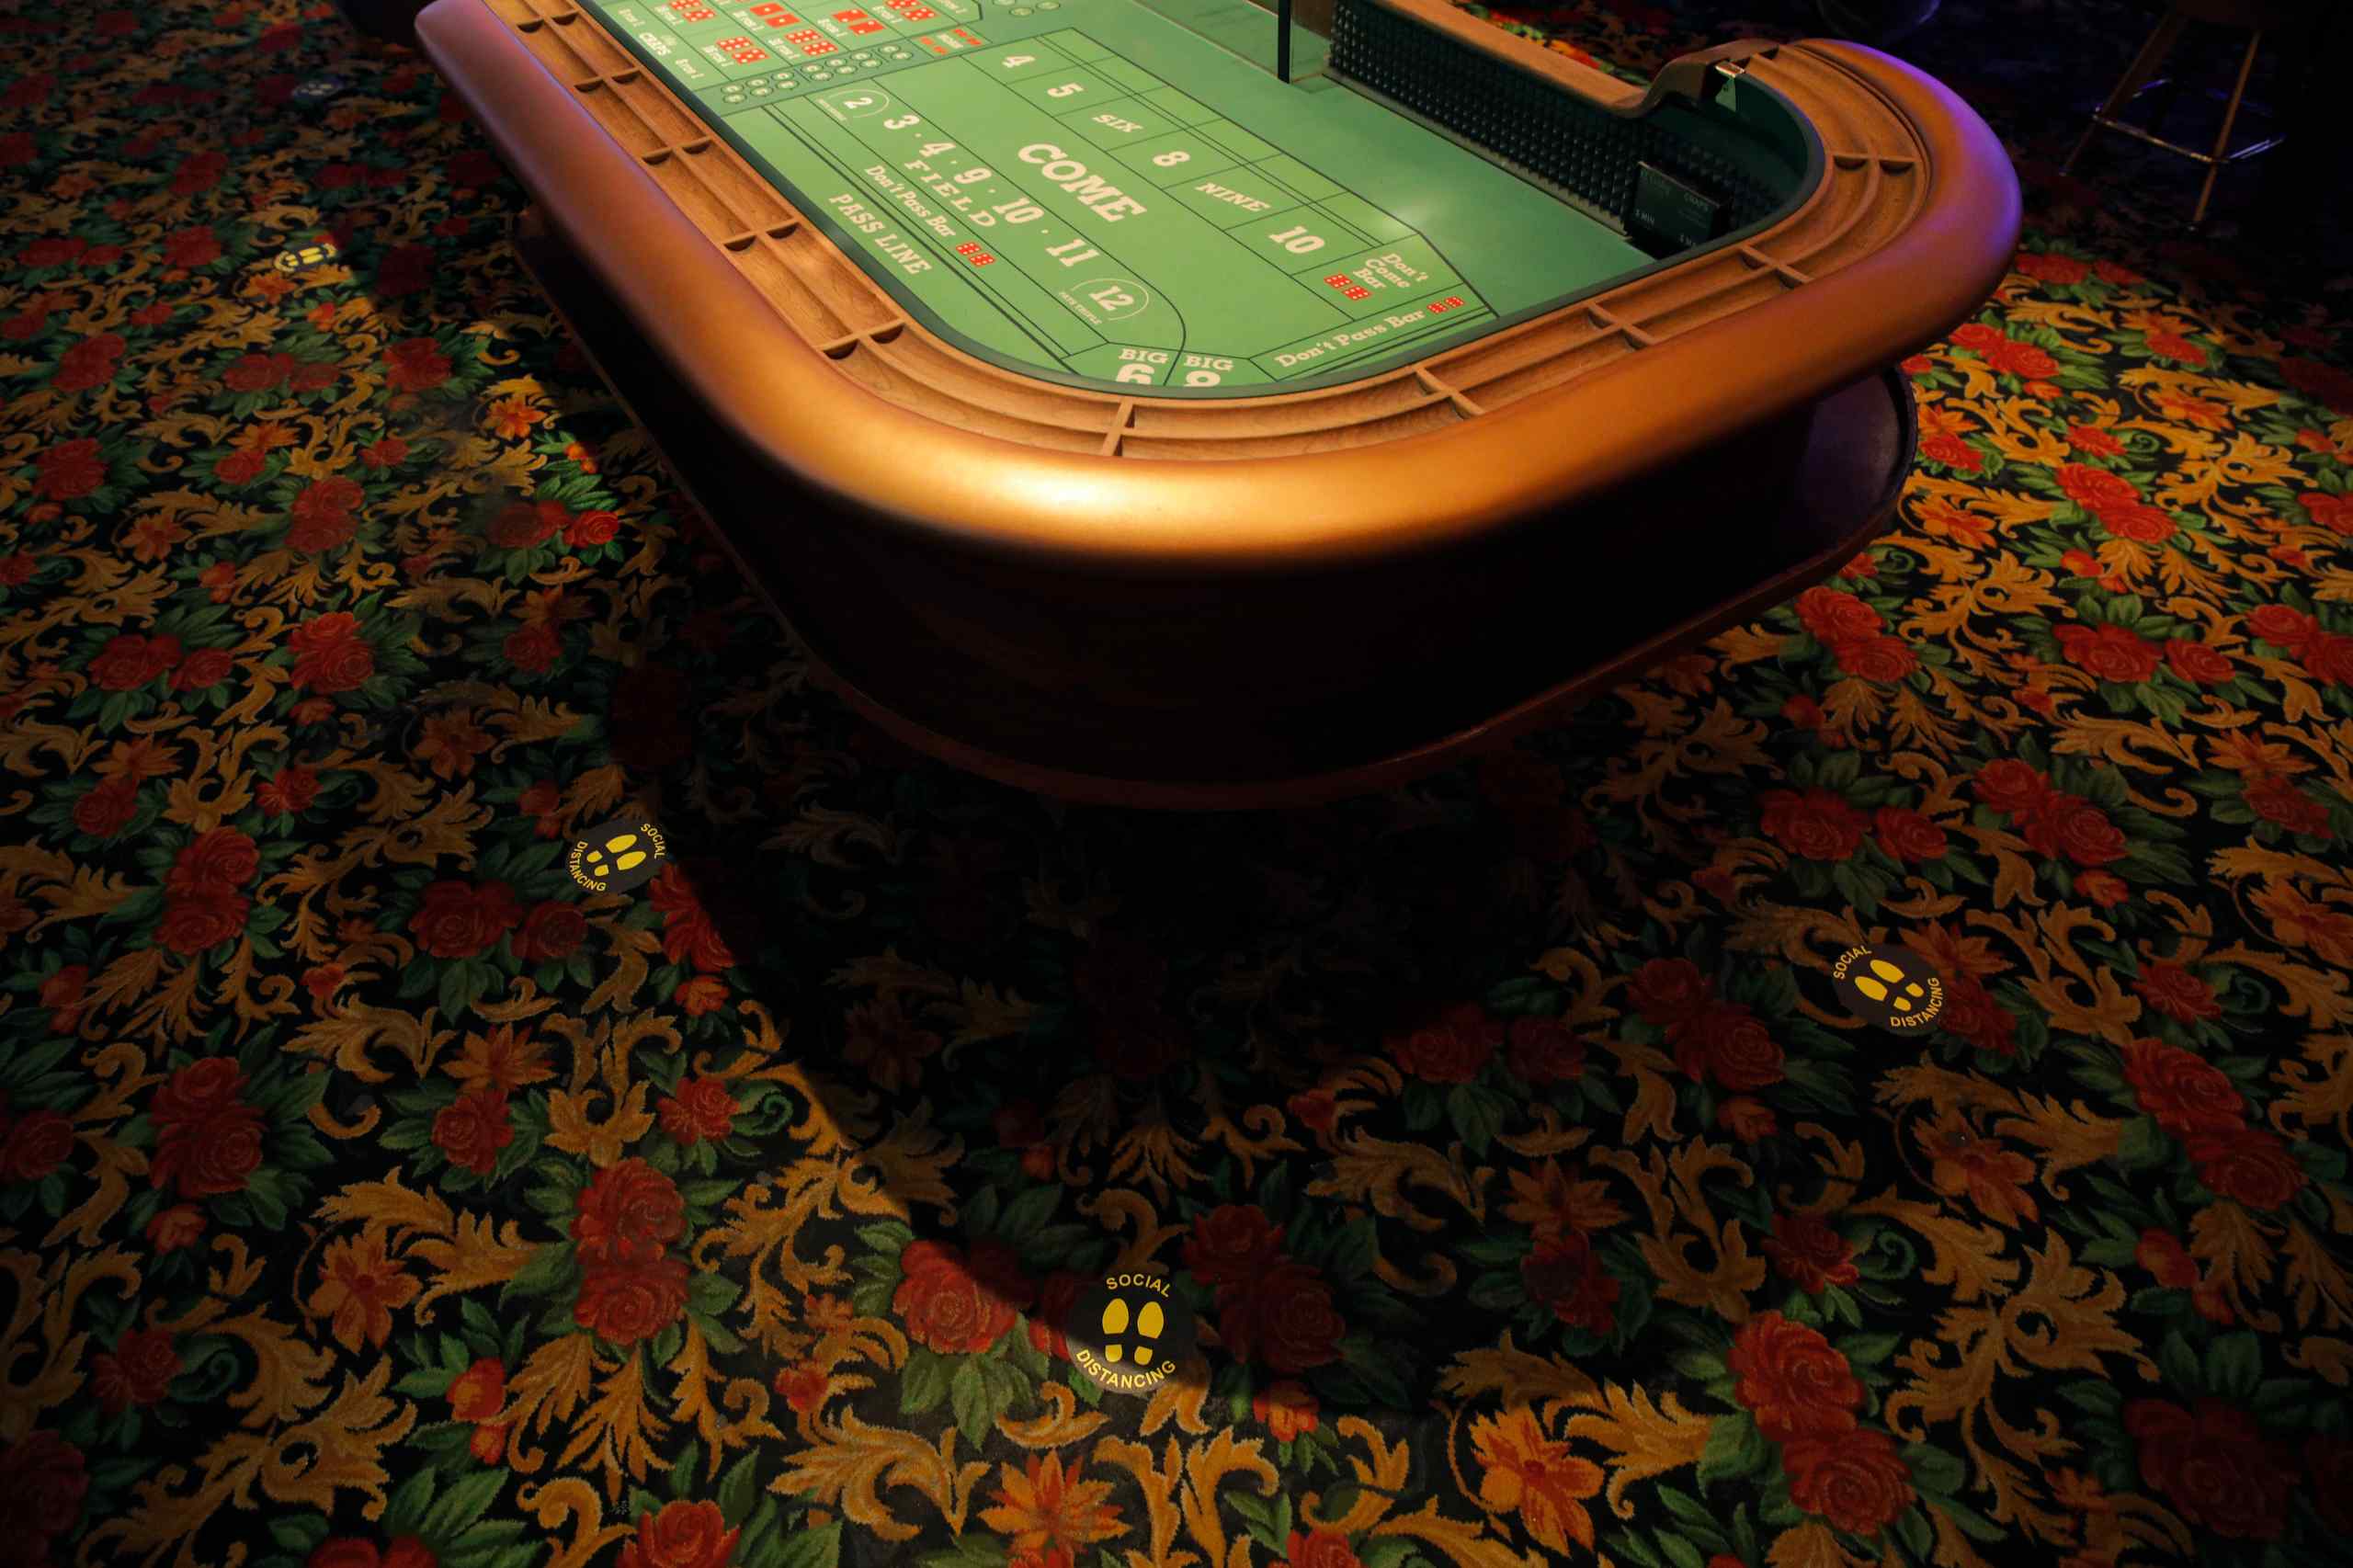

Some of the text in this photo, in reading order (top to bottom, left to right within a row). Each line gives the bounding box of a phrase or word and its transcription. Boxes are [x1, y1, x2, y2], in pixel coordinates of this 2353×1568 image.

[1001, 55, 1036, 69] 4
[844, 97, 874, 109] 2
[1047, 83, 1085, 98] 5
[1092, 113, 1143, 133] SIX
[1152, 151, 1191, 167] 8
[883, 114, 1100, 267] 3 4 9 10 11
[1017, 143, 1147, 222] COME
[1195, 182, 1272, 212] NINE
[896, 190, 931, 217] Pass
[925, 215, 957, 237] Bar
[828, 193, 933, 275] PASS LINE
[1268, 225, 1325, 254] 10
[1352, 267, 1387, 290] Bar
[1365, 257, 1411, 289] Come
[1381, 253, 1429, 282] Don't
[1088, 285, 1135, 312] 12
[1274, 309, 1426, 368] Don't Pass Bar
[1118, 347, 1169, 364] BIG
[1184, 355, 1234, 372] BIG
[640, 823, 666, 859] SOCIAL
[569, 840, 607, 892] DISTANCING
[1833, 945, 1872, 980] SOCIAL
[1889, 977, 1943, 1028] DISTANCING
[1106, 1274, 1171, 1298] SOCIAL
[1075, 1349, 1176, 1389] DISTANCING
